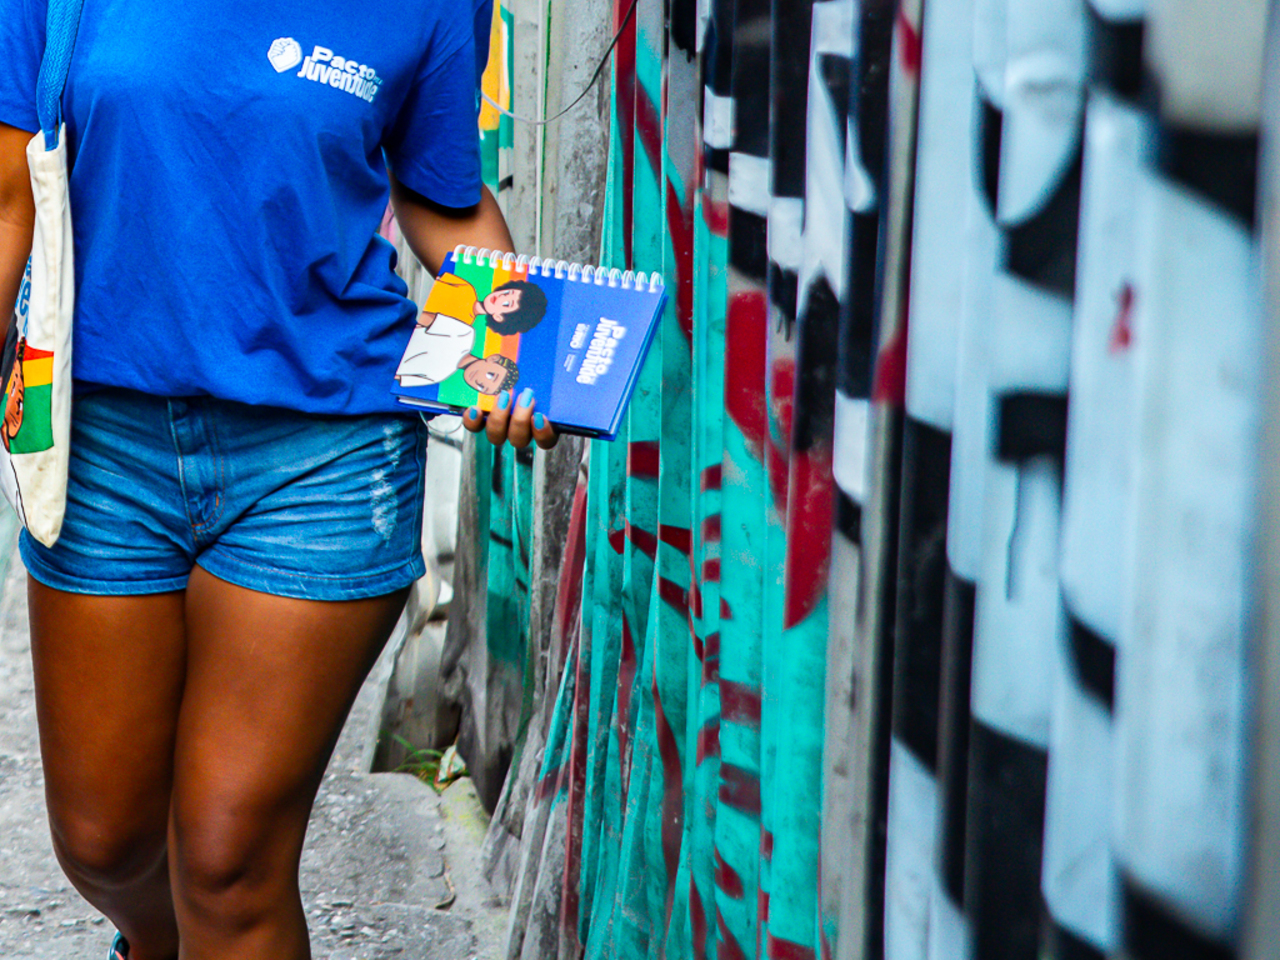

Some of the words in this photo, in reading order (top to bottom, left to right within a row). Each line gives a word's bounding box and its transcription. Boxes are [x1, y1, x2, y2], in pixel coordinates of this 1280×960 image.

[311, 45, 376, 80] Pacto
[576, 317, 618, 385] Juventude
[595, 325, 627, 375] Pacto
